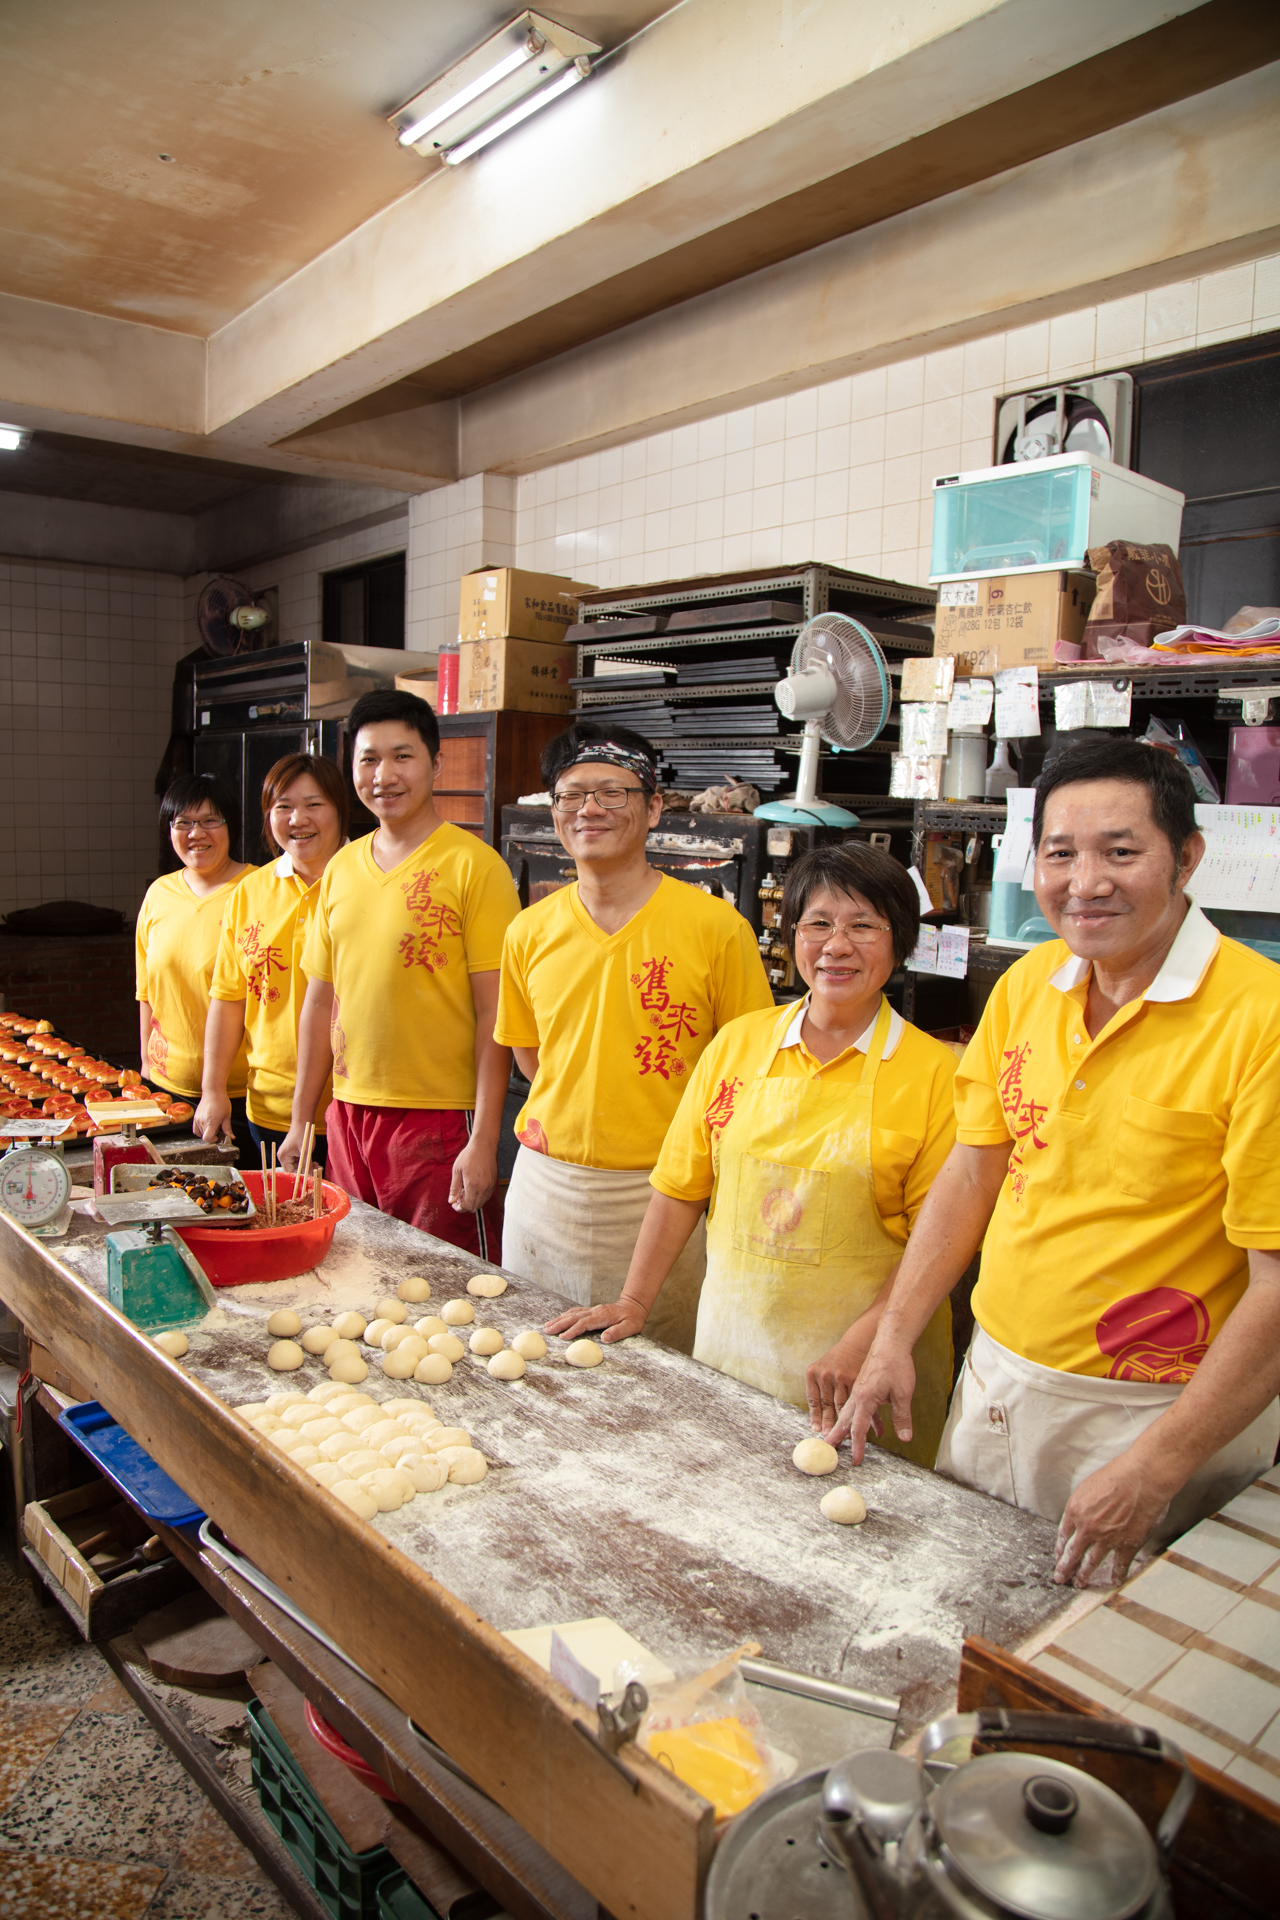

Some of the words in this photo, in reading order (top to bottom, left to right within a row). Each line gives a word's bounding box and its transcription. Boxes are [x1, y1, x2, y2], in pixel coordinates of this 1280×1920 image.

[987, 602, 1032, 617] 元氣杏仁飲
